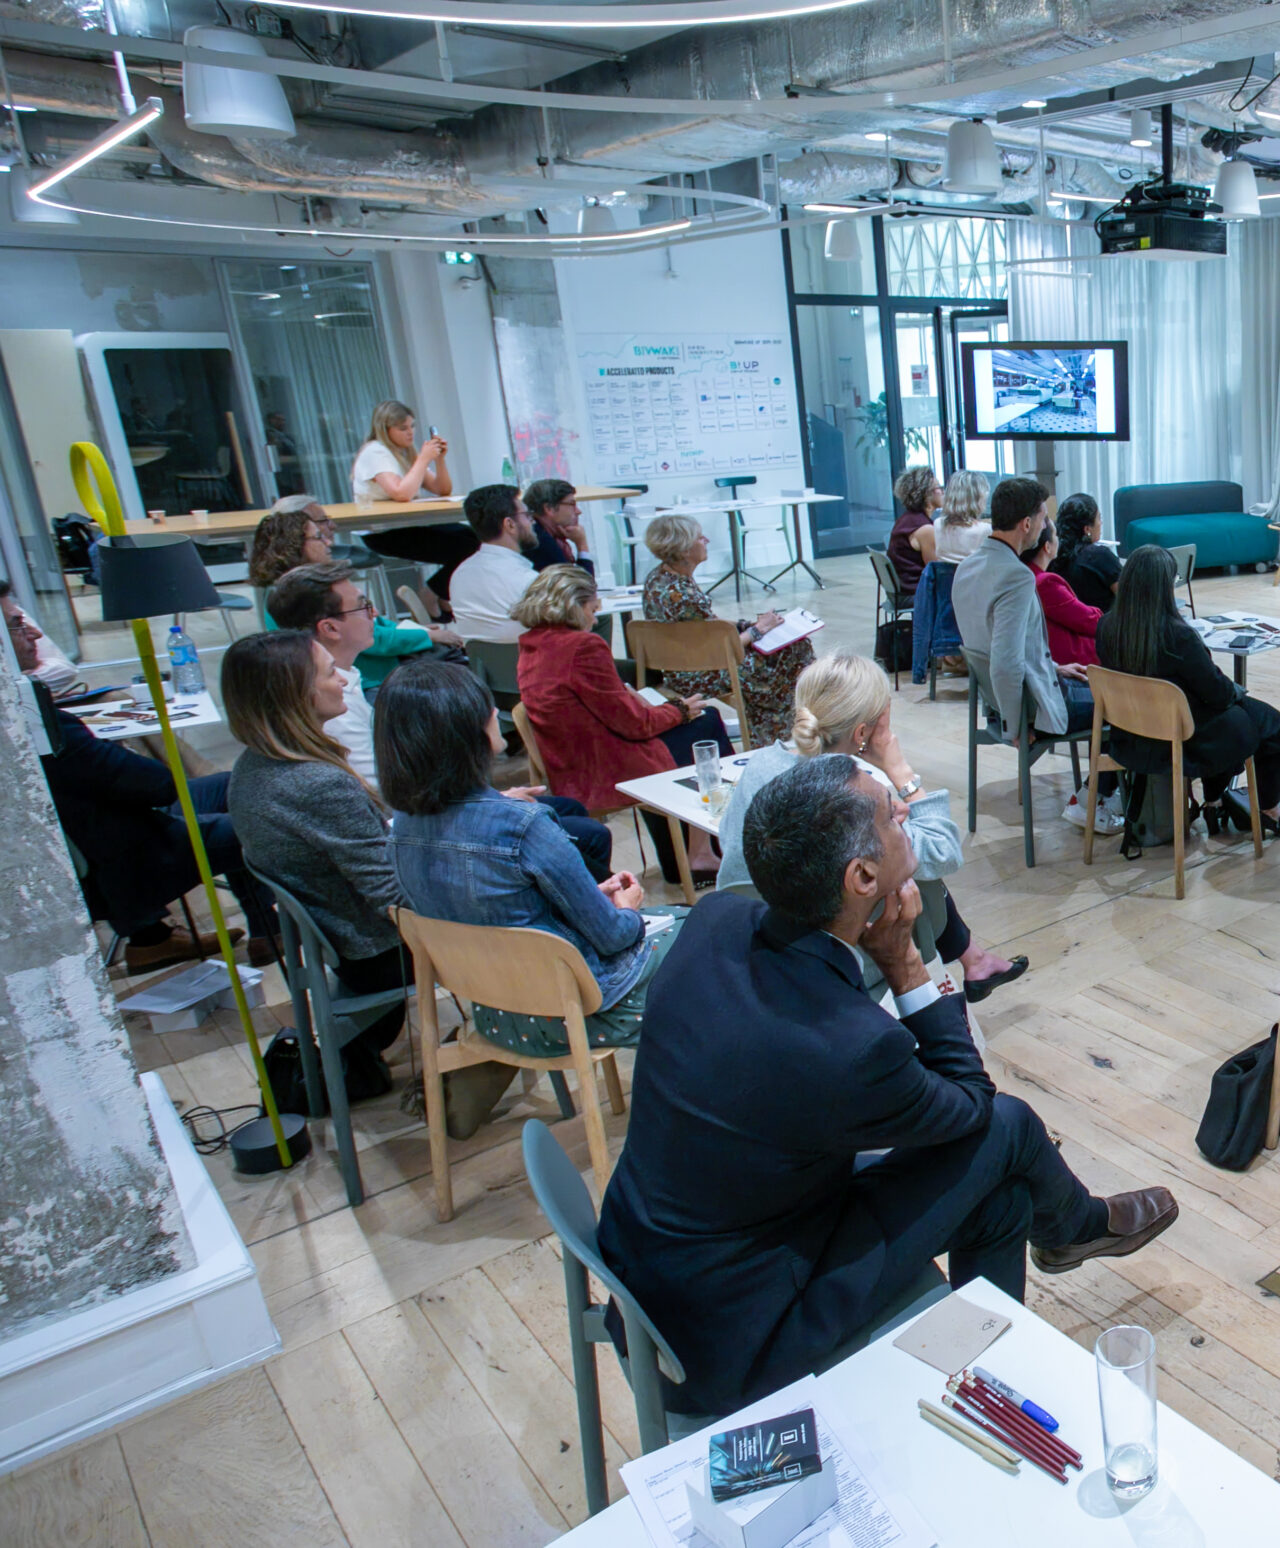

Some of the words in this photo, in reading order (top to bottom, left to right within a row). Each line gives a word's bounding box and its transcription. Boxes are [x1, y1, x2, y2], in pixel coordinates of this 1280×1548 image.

[743, 361, 760, 369] UP
[606, 367, 645, 377] ACCELERATED
[645, 366, 675, 375] PRODUCTS
